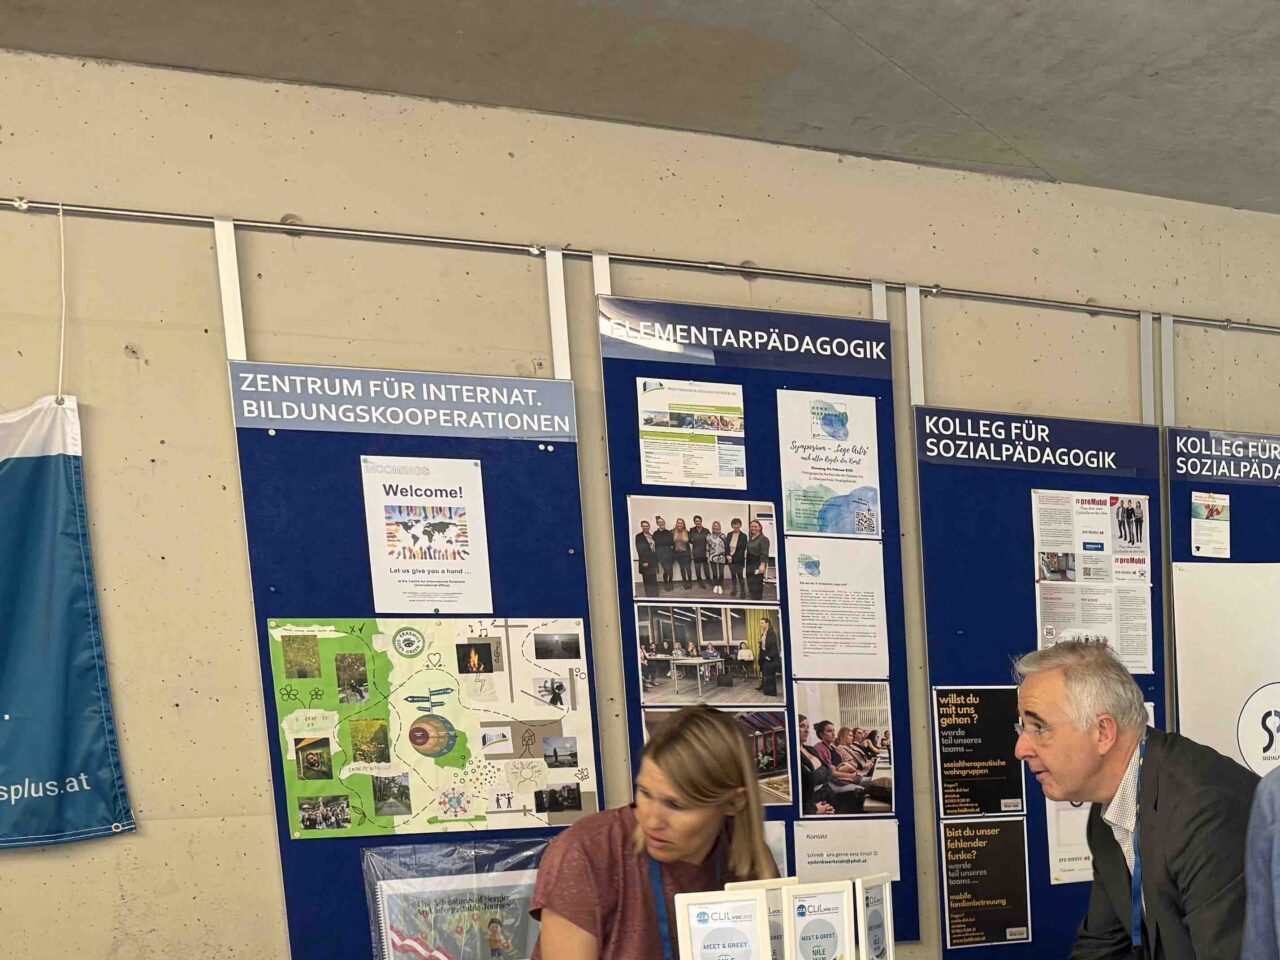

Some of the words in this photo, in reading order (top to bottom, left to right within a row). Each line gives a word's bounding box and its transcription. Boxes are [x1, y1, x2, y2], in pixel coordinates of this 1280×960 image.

[610, 320, 887, 360] ELEMENTARPÄDAGOGIK
[239, 373, 363, 397] ZENTRUM
[369, 377, 416, 400] FÜR
[422, 382, 542, 407] INTERNAT.
[242, 399, 570, 432] BILDUNGSKOOPERATIONEN
[924, 416, 1006, 440] KOLLEG
[1010, 420, 1050, 443] FÜR
[925, 438, 1116, 469] SOZIALPÄDAGOGIK
[1176, 436, 1244, 457] KOLLEG
[1248, 439, 1280, 460] FÜR
[382, 483, 464, 499] Welcome!
[938, 693, 965, 704] willst
[966, 693, 979, 704] du
[939, 704, 957, 714] mit
[958, 706, 975, 714] uns
[940, 715, 971, 727] gehen
[940, 728, 966, 736] werde
[941, 745, 965, 753] teams
[946, 828, 962, 837] bist
[963, 827, 974, 836] du
[976, 828, 1000, 836] unser
[947, 838, 988, 849] fehlender
[947, 850, 977, 861] funke?
[727, 941, 748, 949] GREET
[812, 948, 826, 956] NILE
